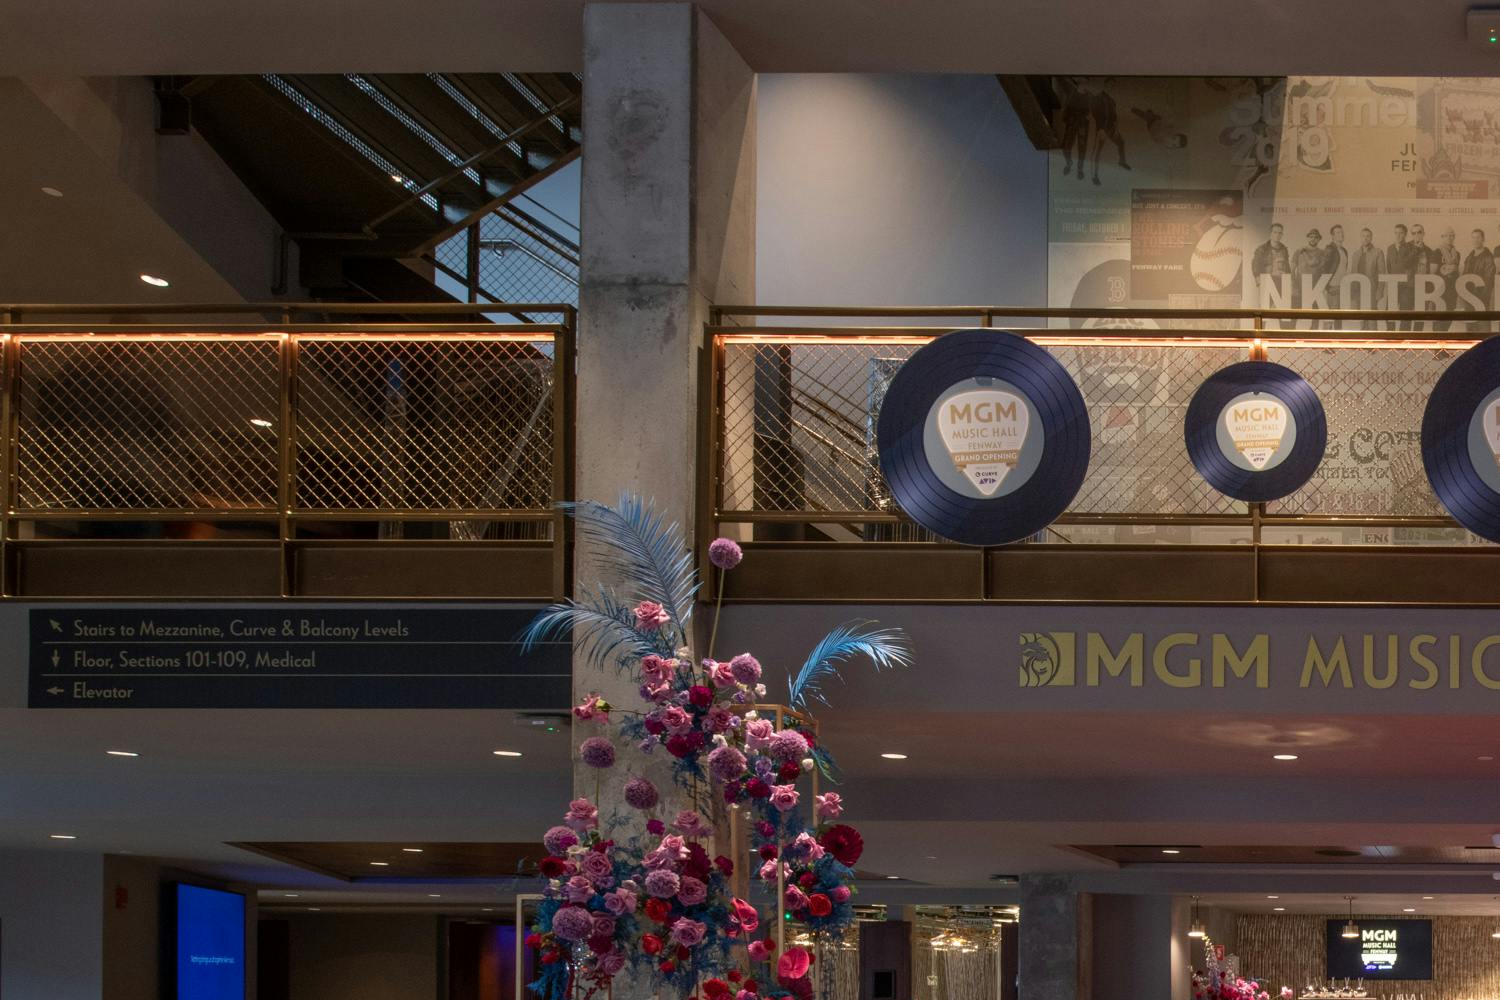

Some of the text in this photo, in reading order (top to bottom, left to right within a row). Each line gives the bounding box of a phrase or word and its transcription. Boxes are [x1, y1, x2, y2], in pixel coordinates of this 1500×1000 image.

[949, 401, 1017, 424] MGM
[1233, 407, 1279, 422] MGM
[952, 427, 1017, 440] MUSIC HALL
[1262, 423, 1279, 431] HALL
[968, 441, 1002, 450] FENWAY
[955, 452, 1017, 462] GRAND OPENING
[75, 618, 409, 641] Stairs to Mezzanine, Curve & Balcony Levels
[74, 650, 316, 670] Floor, Sections 101-109, Medical
[1086, 632, 1270, 690] MGM
[74, 682, 134, 700] Elevator
[1362, 929, 1397, 942] MGM
